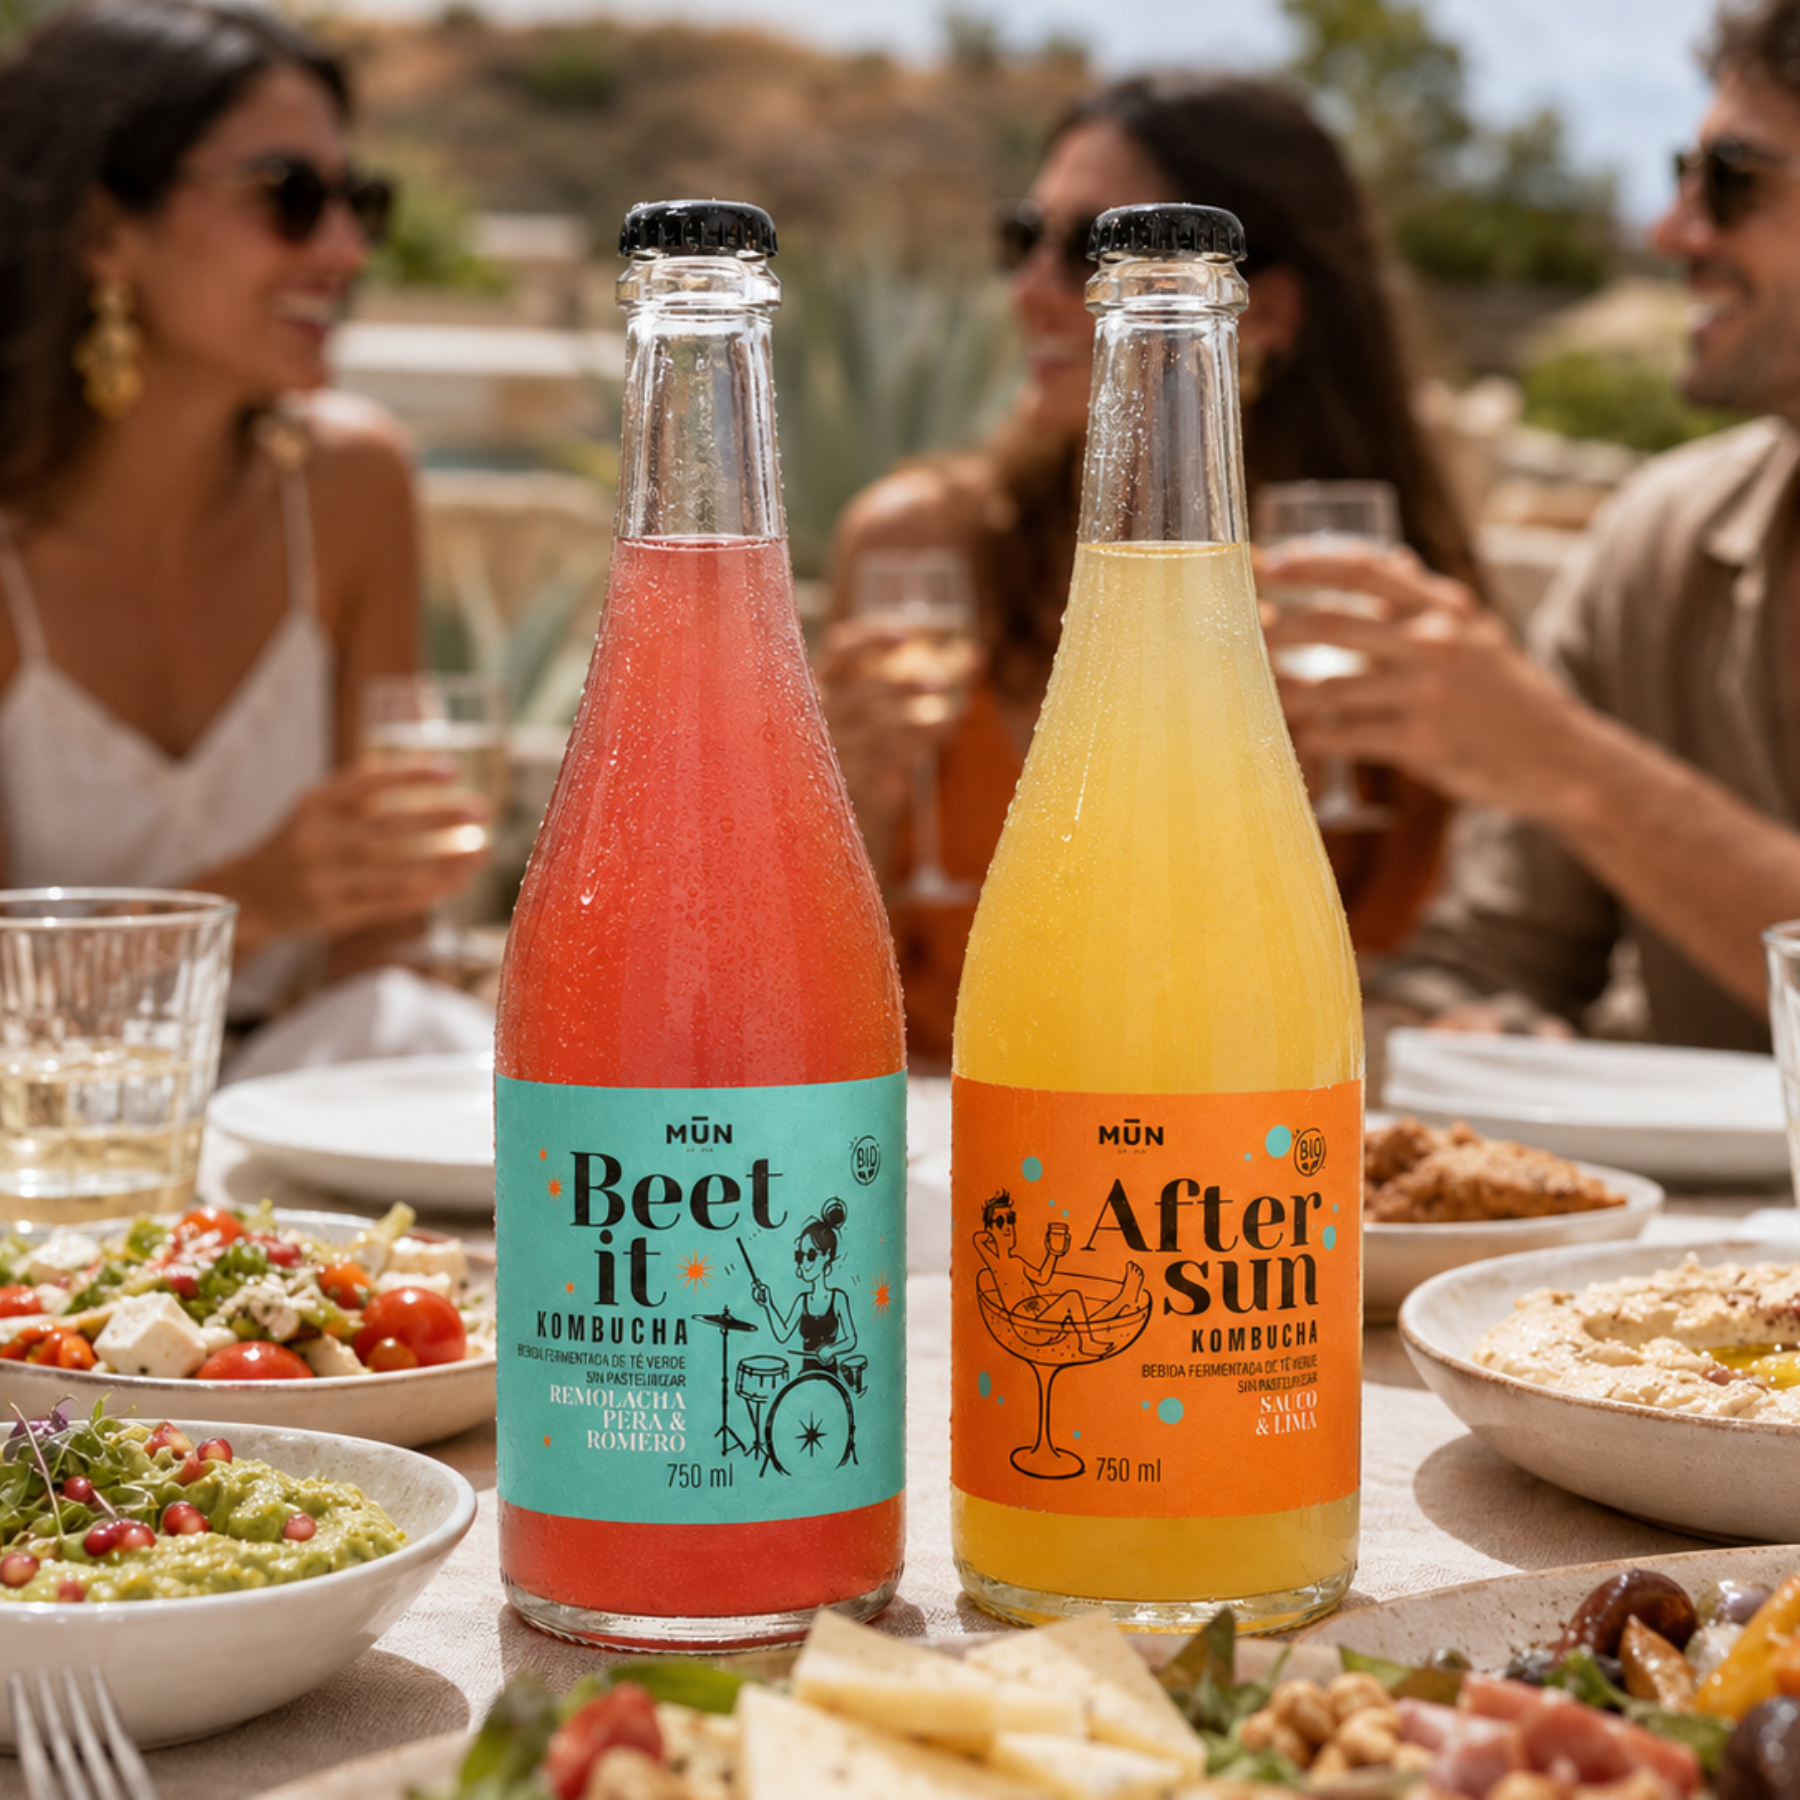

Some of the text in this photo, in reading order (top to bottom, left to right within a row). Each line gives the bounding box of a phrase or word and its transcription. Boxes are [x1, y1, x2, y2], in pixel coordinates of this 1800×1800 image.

[857, 1144, 878, 1169] BIO
[1300, 1136, 1322, 1160] BIO
[570, 1151, 788, 1231] Beet
[1080, 1178, 1323, 1253] After
[593, 1229, 667, 1307] it
[1163, 1253, 1319, 1316] sun
[537, 1310, 688, 1345] KOMBUCHA
[1191, 1319, 1318, 1353] KOMBUCHA
[646, 1355, 686, 1370] VERDE
[1141, 1363, 1186, 1378] BEBIDA
[586, 1370, 604, 1384] SIN
[550, 1384, 687, 1410] REMOLACHA
[603, 1409, 687, 1431] PERA &
[1255, 1410, 1318, 1436] & LIMA
[587, 1429, 687, 1453] ROMERO
[666, 1463, 733, 1488] 750 ml
[1096, 1457, 1161, 1482] 750 ml
